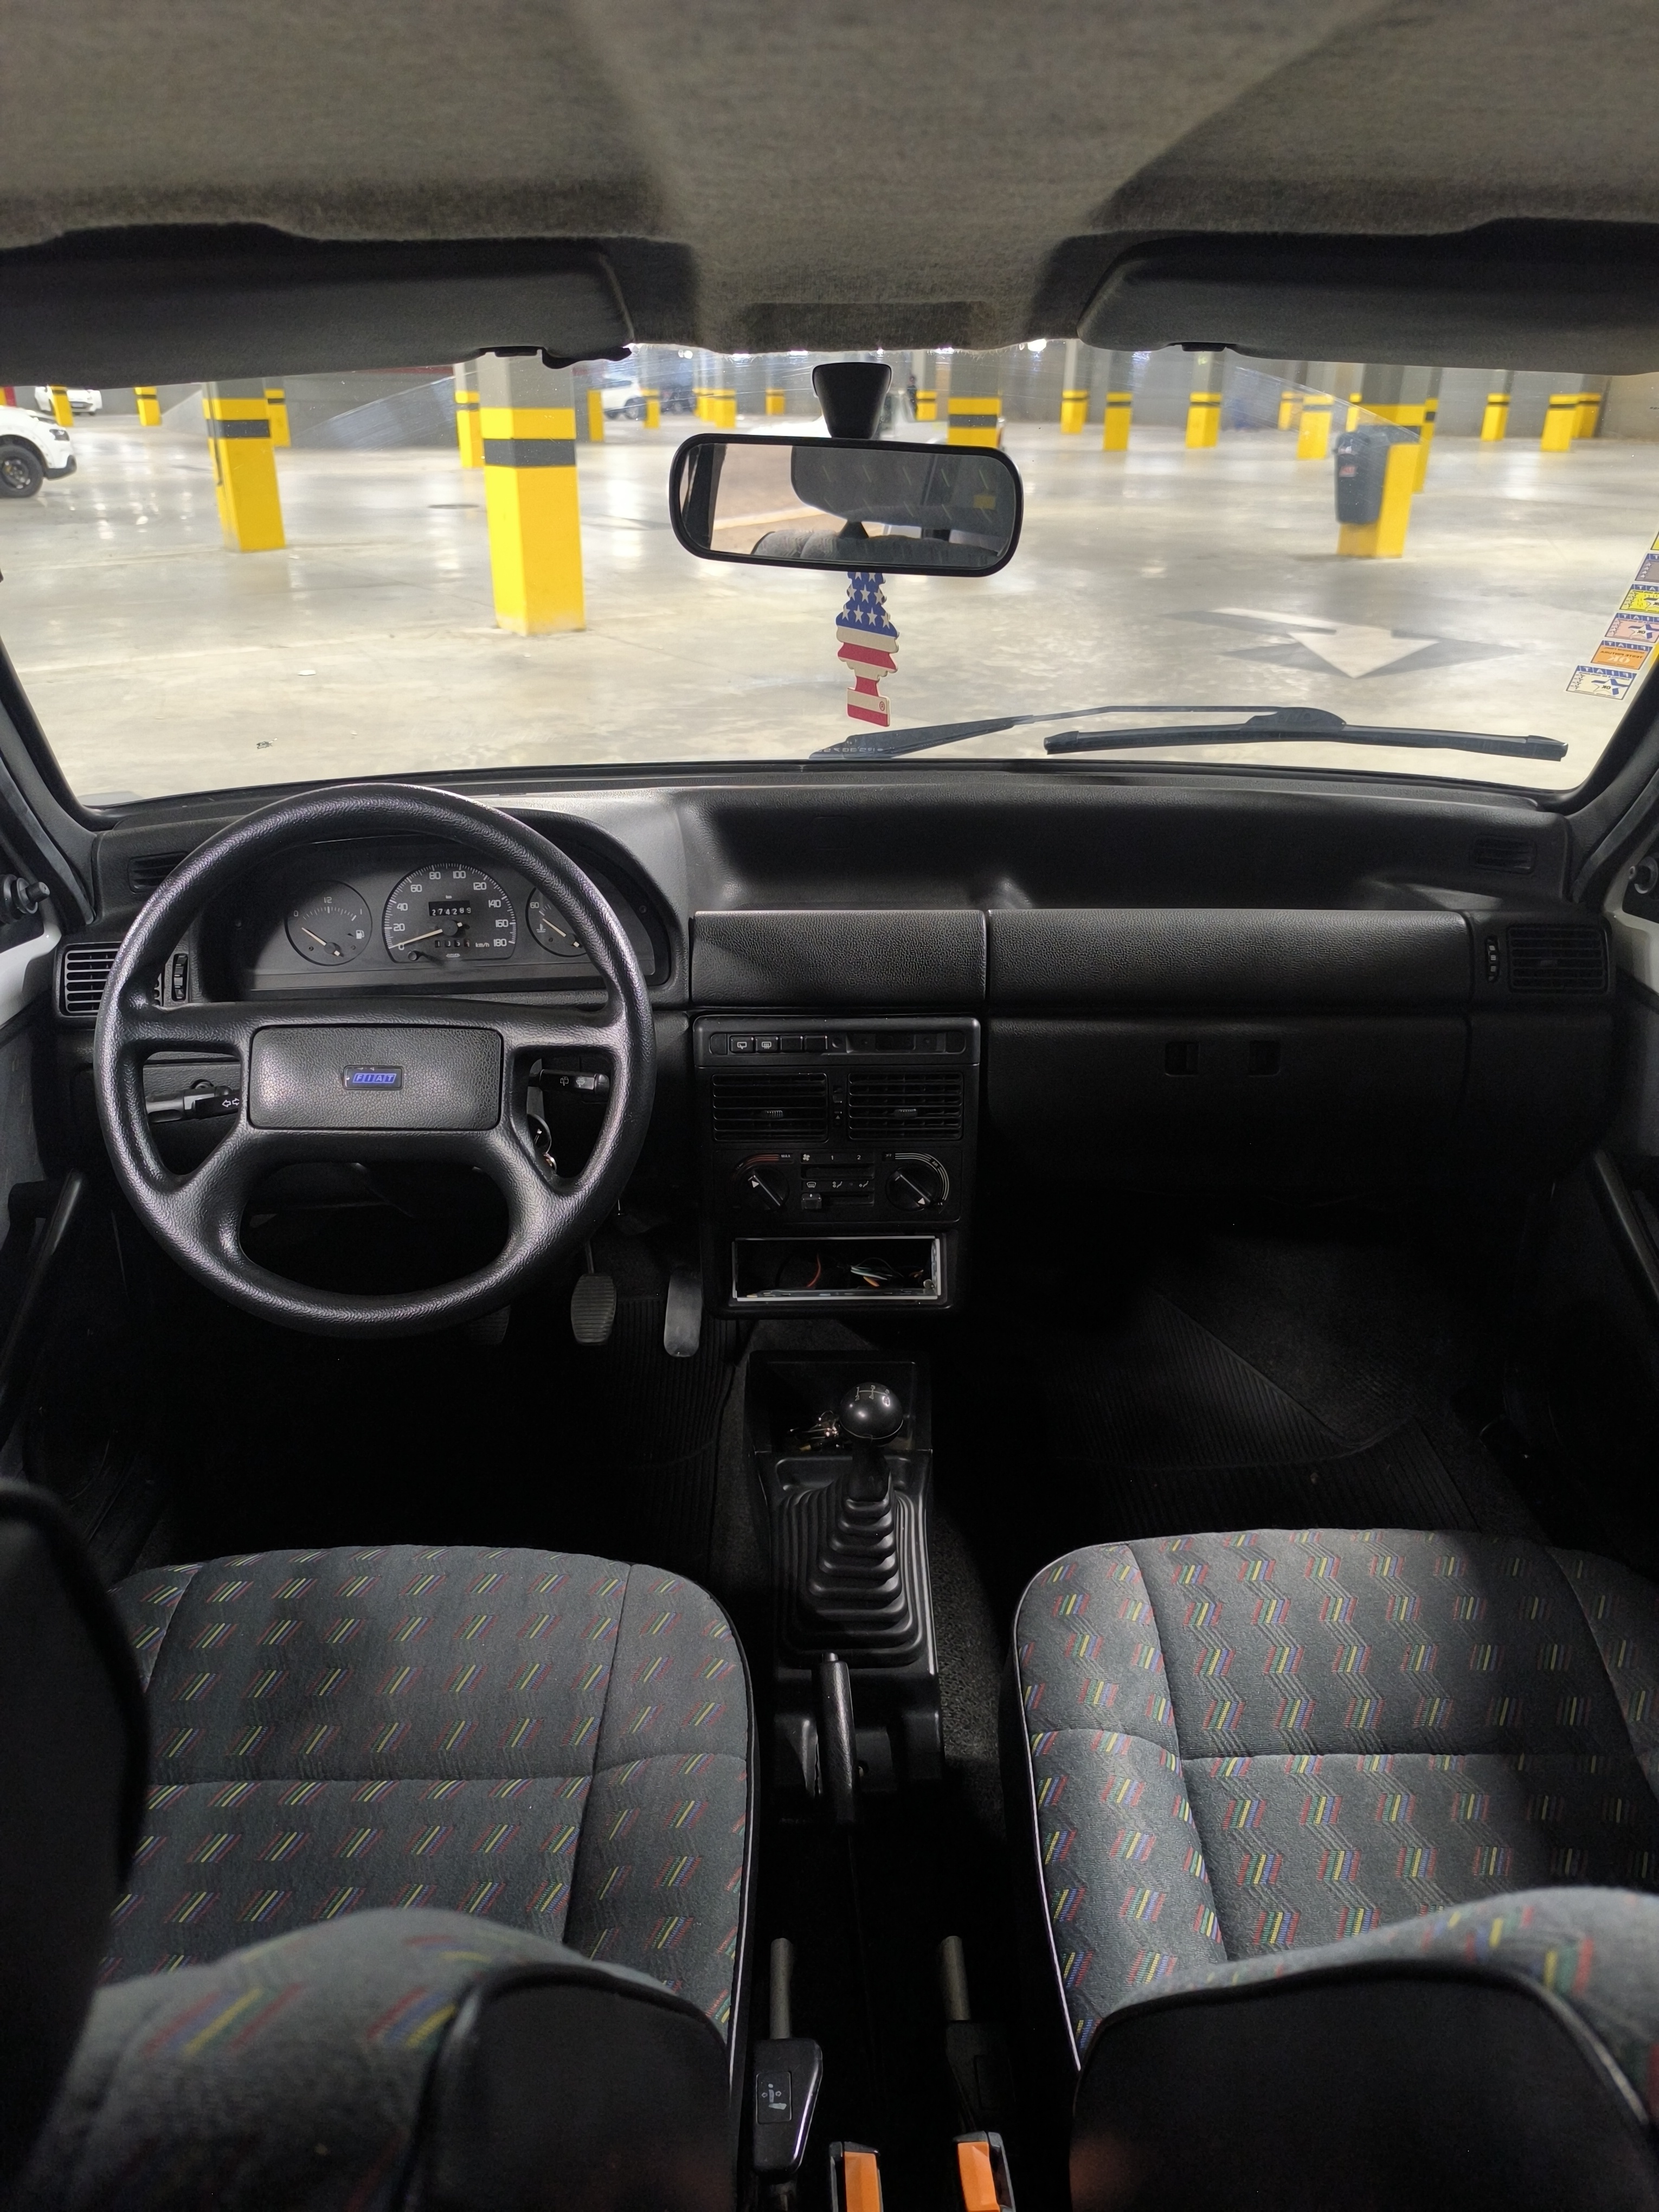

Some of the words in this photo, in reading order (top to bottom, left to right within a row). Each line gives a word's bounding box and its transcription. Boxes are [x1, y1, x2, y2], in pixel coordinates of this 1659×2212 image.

[429, 871, 441, 879] 80
[453, 870, 466, 879] 100
[410, 884, 422, 892] 60
[473, 882, 487, 890] 120
[396, 903, 408, 911] 40
[488, 899, 501, 908] 140
[393, 923, 406, 931] 20
[495, 919, 509, 928] 160
[493, 938, 507, 947] 180
[356, 1074, 394, 1082] FIAT
